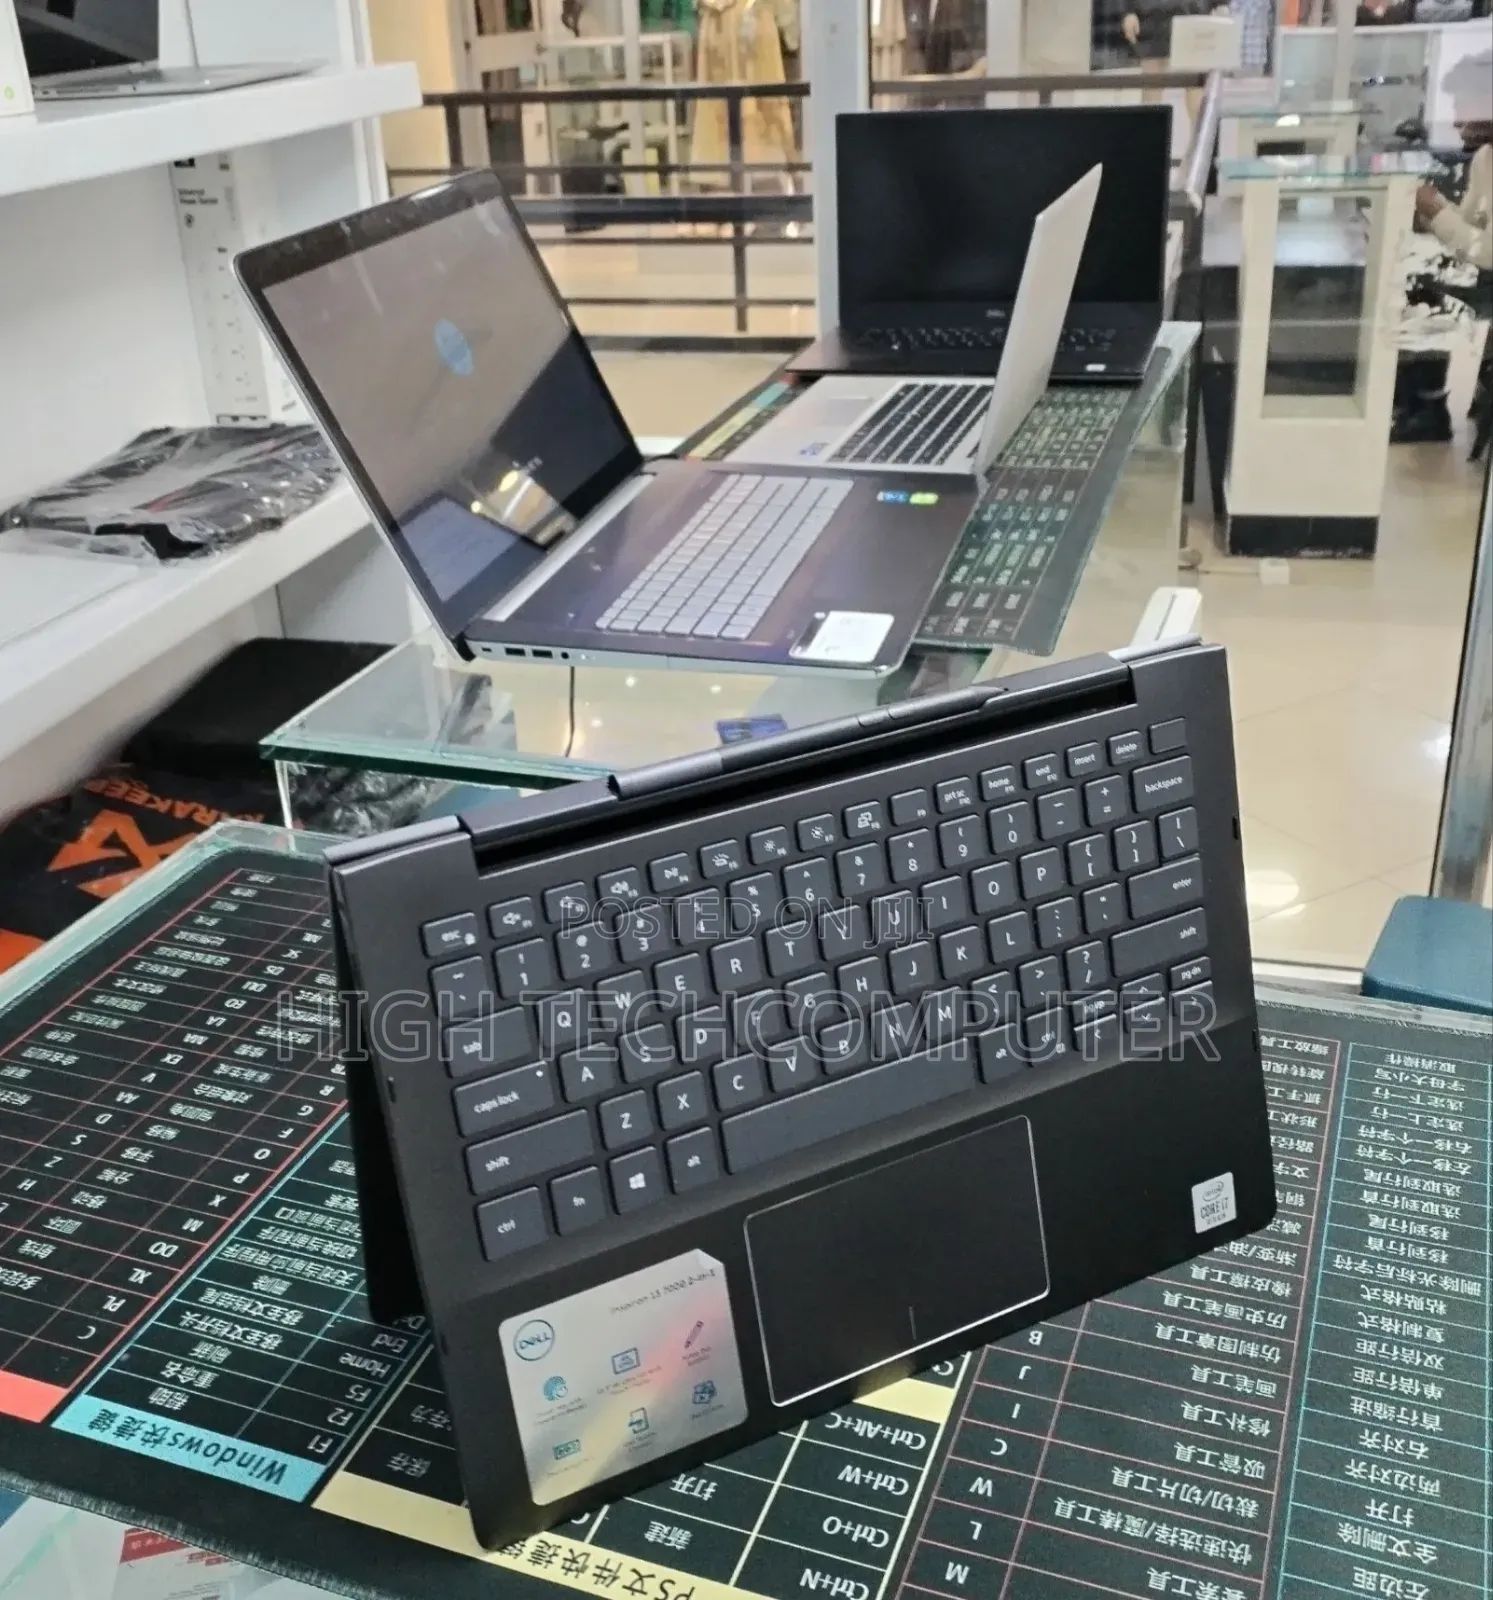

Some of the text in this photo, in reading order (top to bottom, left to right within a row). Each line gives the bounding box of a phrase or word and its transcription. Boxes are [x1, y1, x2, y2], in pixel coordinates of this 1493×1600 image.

[1145, 776, 1183, 792] backspace
[959, 844, 967, 857] 9
[908, 859, 918, 872] 8
[1037, 867, 1046, 881] P
[857, 873, 865, 886] 7
[805, 888, 814, 901] 6
[639, 937, 648, 951] 3
[785, 941, 795, 956] T
[1006, 932, 1015, 946] L
[580, 954, 591, 968] 2
[956, 946, 967, 960] K
[730, 958, 742, 974] R
[909, 961, 917, 976] J
[675, 975, 686, 991] E
[856, 977, 868, 992] H
[615, 992, 631, 1009] W
[557, 1012, 572, 1028] Q
[938, 1006, 952, 1022] M
[695, 1029, 707, 1044] D
[839, 1039, 850, 1055] B
[582, 1066, 594, 1082] A
[786, 1056, 796, 1072] V
[733, 1075, 744, 1090] C
[1374, 1067, 1465, 1092] 字母大小写
[677, 1094, 689, 1110] X
[1264, 1085, 1321, 1105] 抓手工
[1371, 1086, 1464, 1112] 选定下一行
[297, 1104, 314, 1116] G
[621, 1112, 632, 1128] Z
[1370, 1106, 1464, 1132] 选定上一行
[1357, 1124, 1472, 1155] 右移一个字符
[1355, 1143, 1472, 1176] 左移一个字符
[233, 1172, 250, 1184] P
[1363, 1168, 1461, 1197] 选取到行尾
[208, 1194, 227, 1208] X
[1359, 1189, 1460, 1219] 选取到行首
[1366, 1213, 1449, 1240] 移到行尾
[1364, 1236, 1449, 1264] 移到行首
[1189, 1264, 1292, 1297] 橡皮擦工具
[1331, 1254, 1481, 1297] 删除光标后字符
[102, 1295, 126, 1312] PL
[1162, 1290, 1287, 1330] 历史画笔工具
[1360, 1284, 1447, 1315] 粘贴格式
[1357, 1311, 1444, 1343] 复制格式
[1028, 1330, 1043, 1346] B
[1155, 1322, 1281, 1364] 仿制图章工具
[338, 1352, 391, 1378] Home
[1355, 1338, 1444, 1371] 双倍行距
[160, 1361, 219, 1389] 重命名
[1019, 1365, 1031, 1380] J
[1190, 1364, 1277, 1398] 画笔工具
[1352, 1366, 1443, 1401] 单倍行距
[327, 1407, 354, 1426] F2
[1181, 1401, 1270, 1437] 修补工具
[1349, 1395, 1443, 1432] 首行缩进
[825, 1412, 926, 1450] Ctrl+Alt+C
[307, 1435, 333, 1453] F1
[990, 1438, 1008, 1456] C
[1358, 1428, 1429, 1460] 右对齐
[1174, 1441, 1266, 1480] 吸管工具
[669, 1473, 717, 1501] 打开
[837, 1464, 909, 1496] Ctrl+W
[969, 1476, 993, 1497] W
[1344, 1458, 1440, 1498] 两边对齐
[1110, 1466, 1259, 1519] 裁切/切片工具
[1365, 1499, 1414, 1528] 打开
[644, 1520, 693, 1550] 新建
[822, 1516, 889, 1548] Ctrl+O
[970, 1521, 982, 1540] L
[1053, 1496, 1252, 1566] 快速选择/魔棒工具
[1337, 1522, 1438, 1564] 全文删除
[945, 1561, 970, 1584] M
[800, 1568, 869, 1600] Ctrl+N
